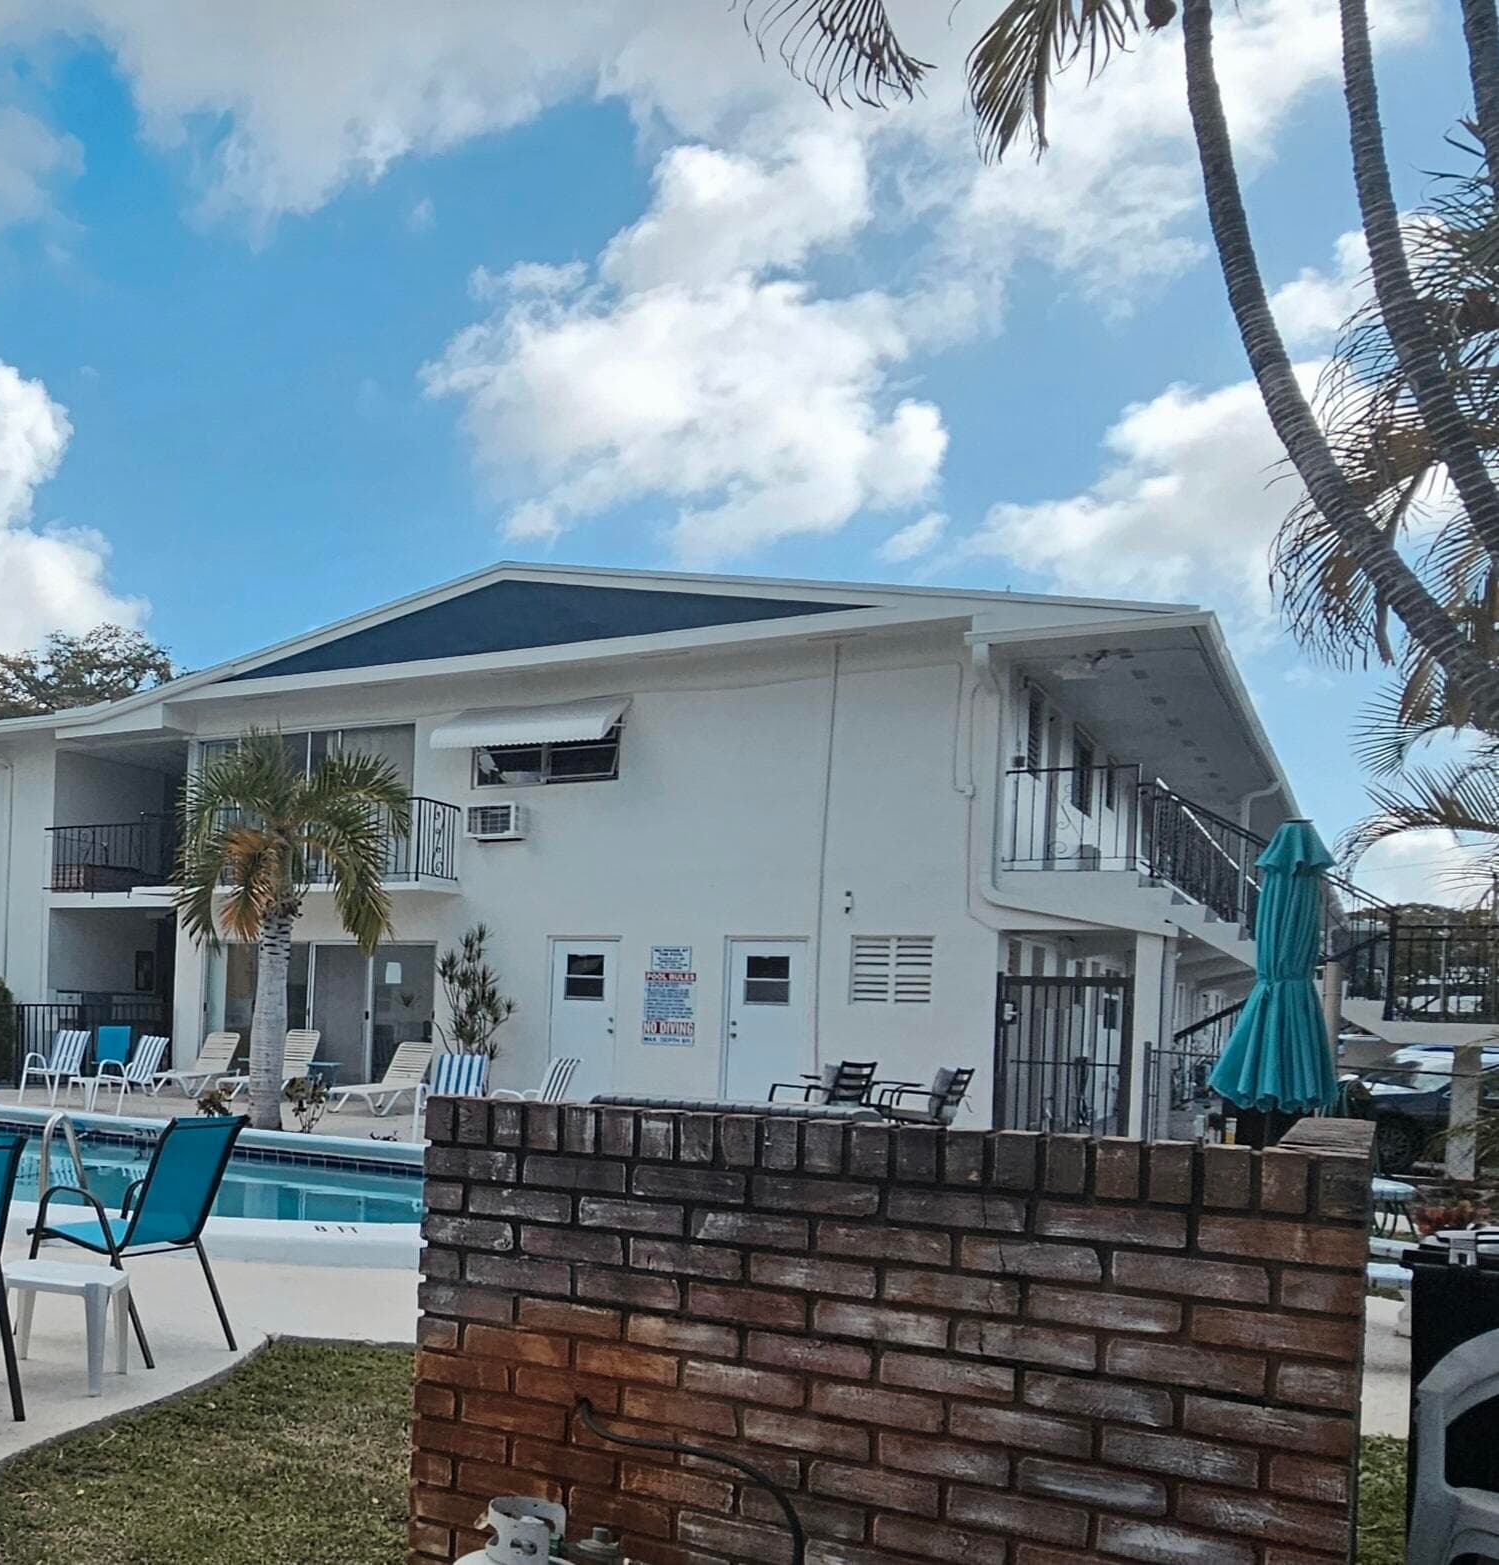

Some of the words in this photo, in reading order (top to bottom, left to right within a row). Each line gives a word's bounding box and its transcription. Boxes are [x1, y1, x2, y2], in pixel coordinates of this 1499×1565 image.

[669, 973, 694, 981] RULES
[644, 1022, 657, 1034] NO
[660, 1022, 693, 1035] DIVING
